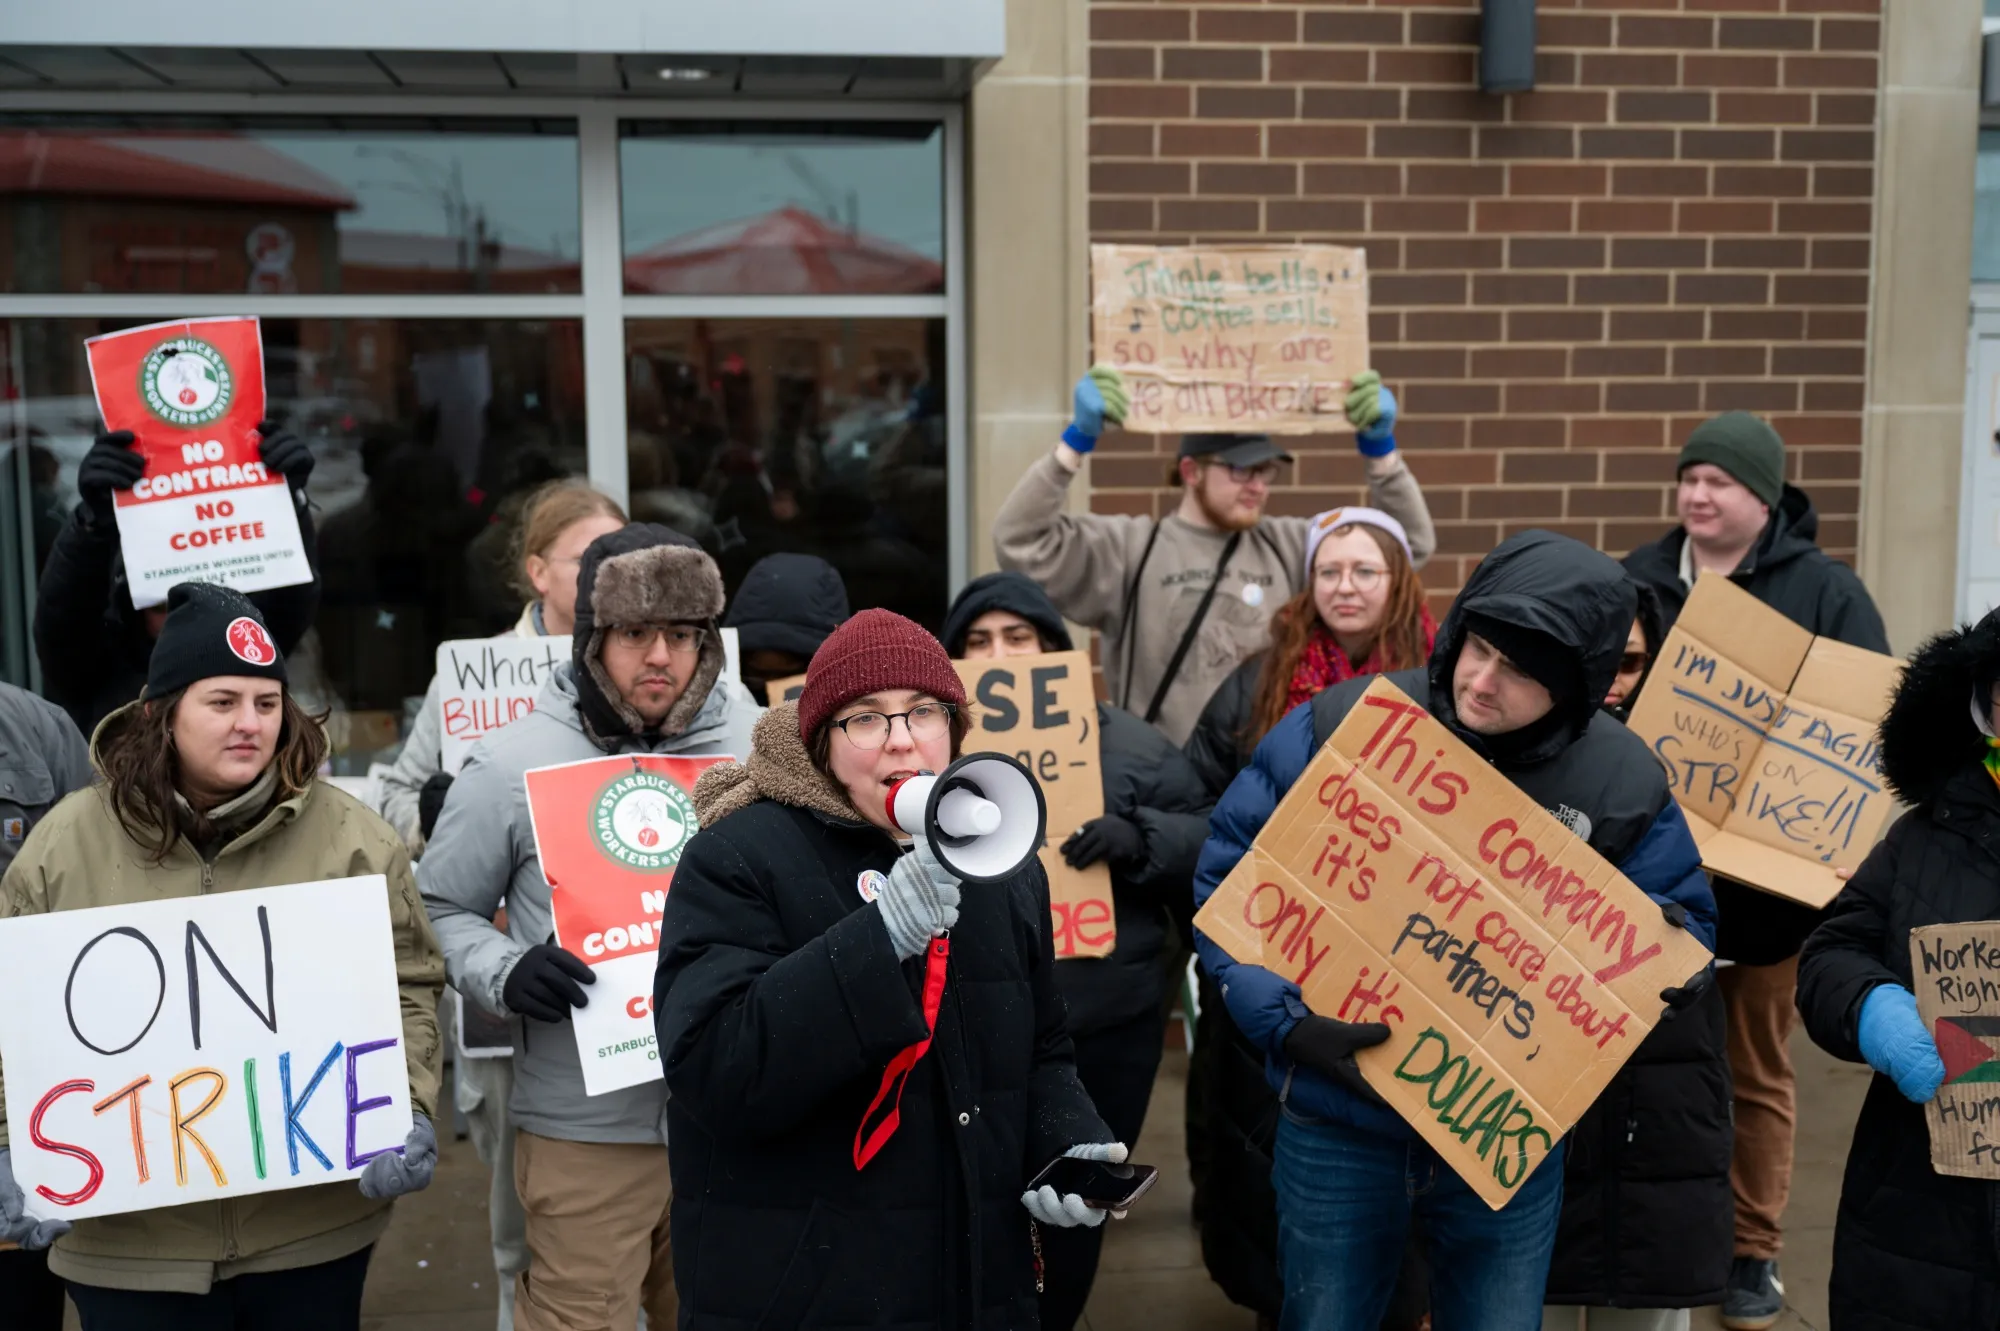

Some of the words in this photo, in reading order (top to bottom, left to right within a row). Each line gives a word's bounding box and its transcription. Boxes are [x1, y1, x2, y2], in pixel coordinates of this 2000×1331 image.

[1113, 340, 1155, 366] so
[1180, 334, 1258, 389] why
[1280, 335, 1334, 364] are
[1175, 380, 1216, 418] all
[181, 440, 225, 465] NO
[132, 462, 269, 500] CONTRACT
[195, 500, 234, 521] NO
[170, 521, 265, 551] COFFEE
[144, 561, 210, 579] STARBUCKS
[212, 552, 261, 569] WORKERS
[263, 548, 296, 561] UNITED
[451, 643, 560, 691] What
[1671, 643, 1717, 684] I'M
[1721, 678, 1804, 730] JUST
[442, 696, 535, 736] BILLIO
[1359, 693, 1470, 816] This
[1674, 709, 1745, 761] WHO'S
[1762, 760, 1819, 787] ON
[600, 774, 688, 810] STARBUCKS
[1558, 802, 1580, 818] THE
[597, 816, 661, 868] WORKERS
[640, 889, 669, 915] N
[1319, 762, 1404, 853] does
[1406, 850, 1485, 923] not
[1475, 911, 1547, 984] care
[1545, 974, 1628, 1050] about
[1311, 833, 1378, 902] it's
[1391, 911, 1542, 1063] partners,
[64, 903, 279, 1056] ON
[1935, 976, 2000, 1014] Righ
[625, 996, 654, 1019] C
[29, 1037, 410, 1207] STRIKE
[1393, 1025, 1553, 1190] DOLLARS
